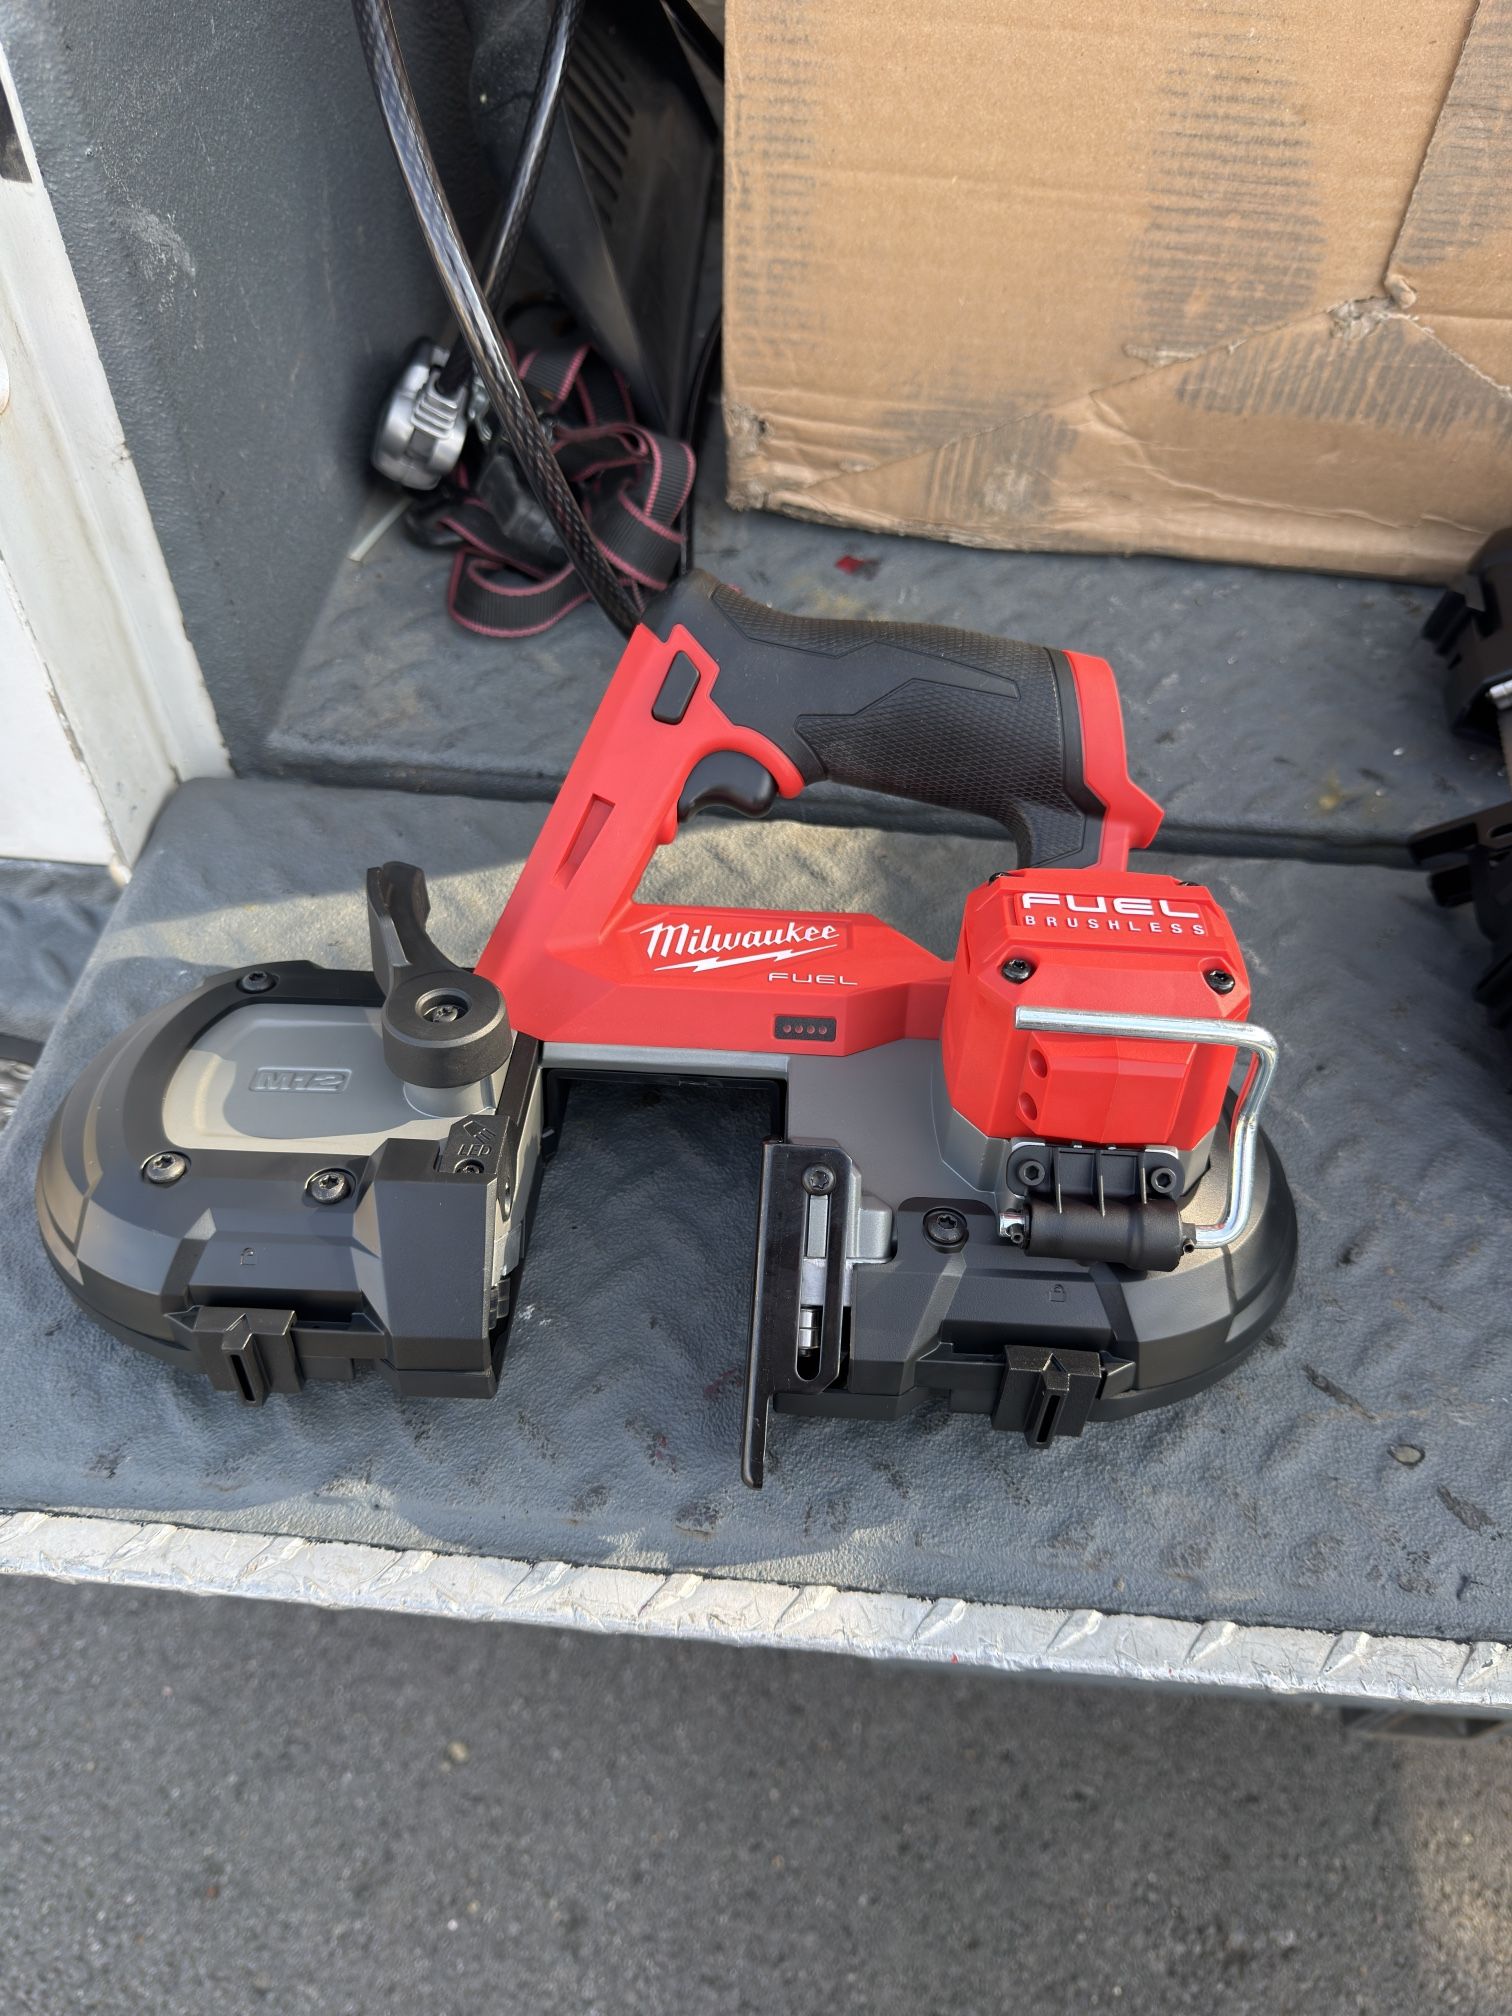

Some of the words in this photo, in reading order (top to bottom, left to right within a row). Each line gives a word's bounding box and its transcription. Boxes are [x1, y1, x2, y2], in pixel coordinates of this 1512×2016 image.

[1022, 893, 1200, 919] FUEL
[1025, 915, 1206, 935] BRUSHLESS
[639, 921, 840, 959] Milwaukee
[767, 972, 858, 986] FUEL
[457, 1144, 493, 1157] LED
